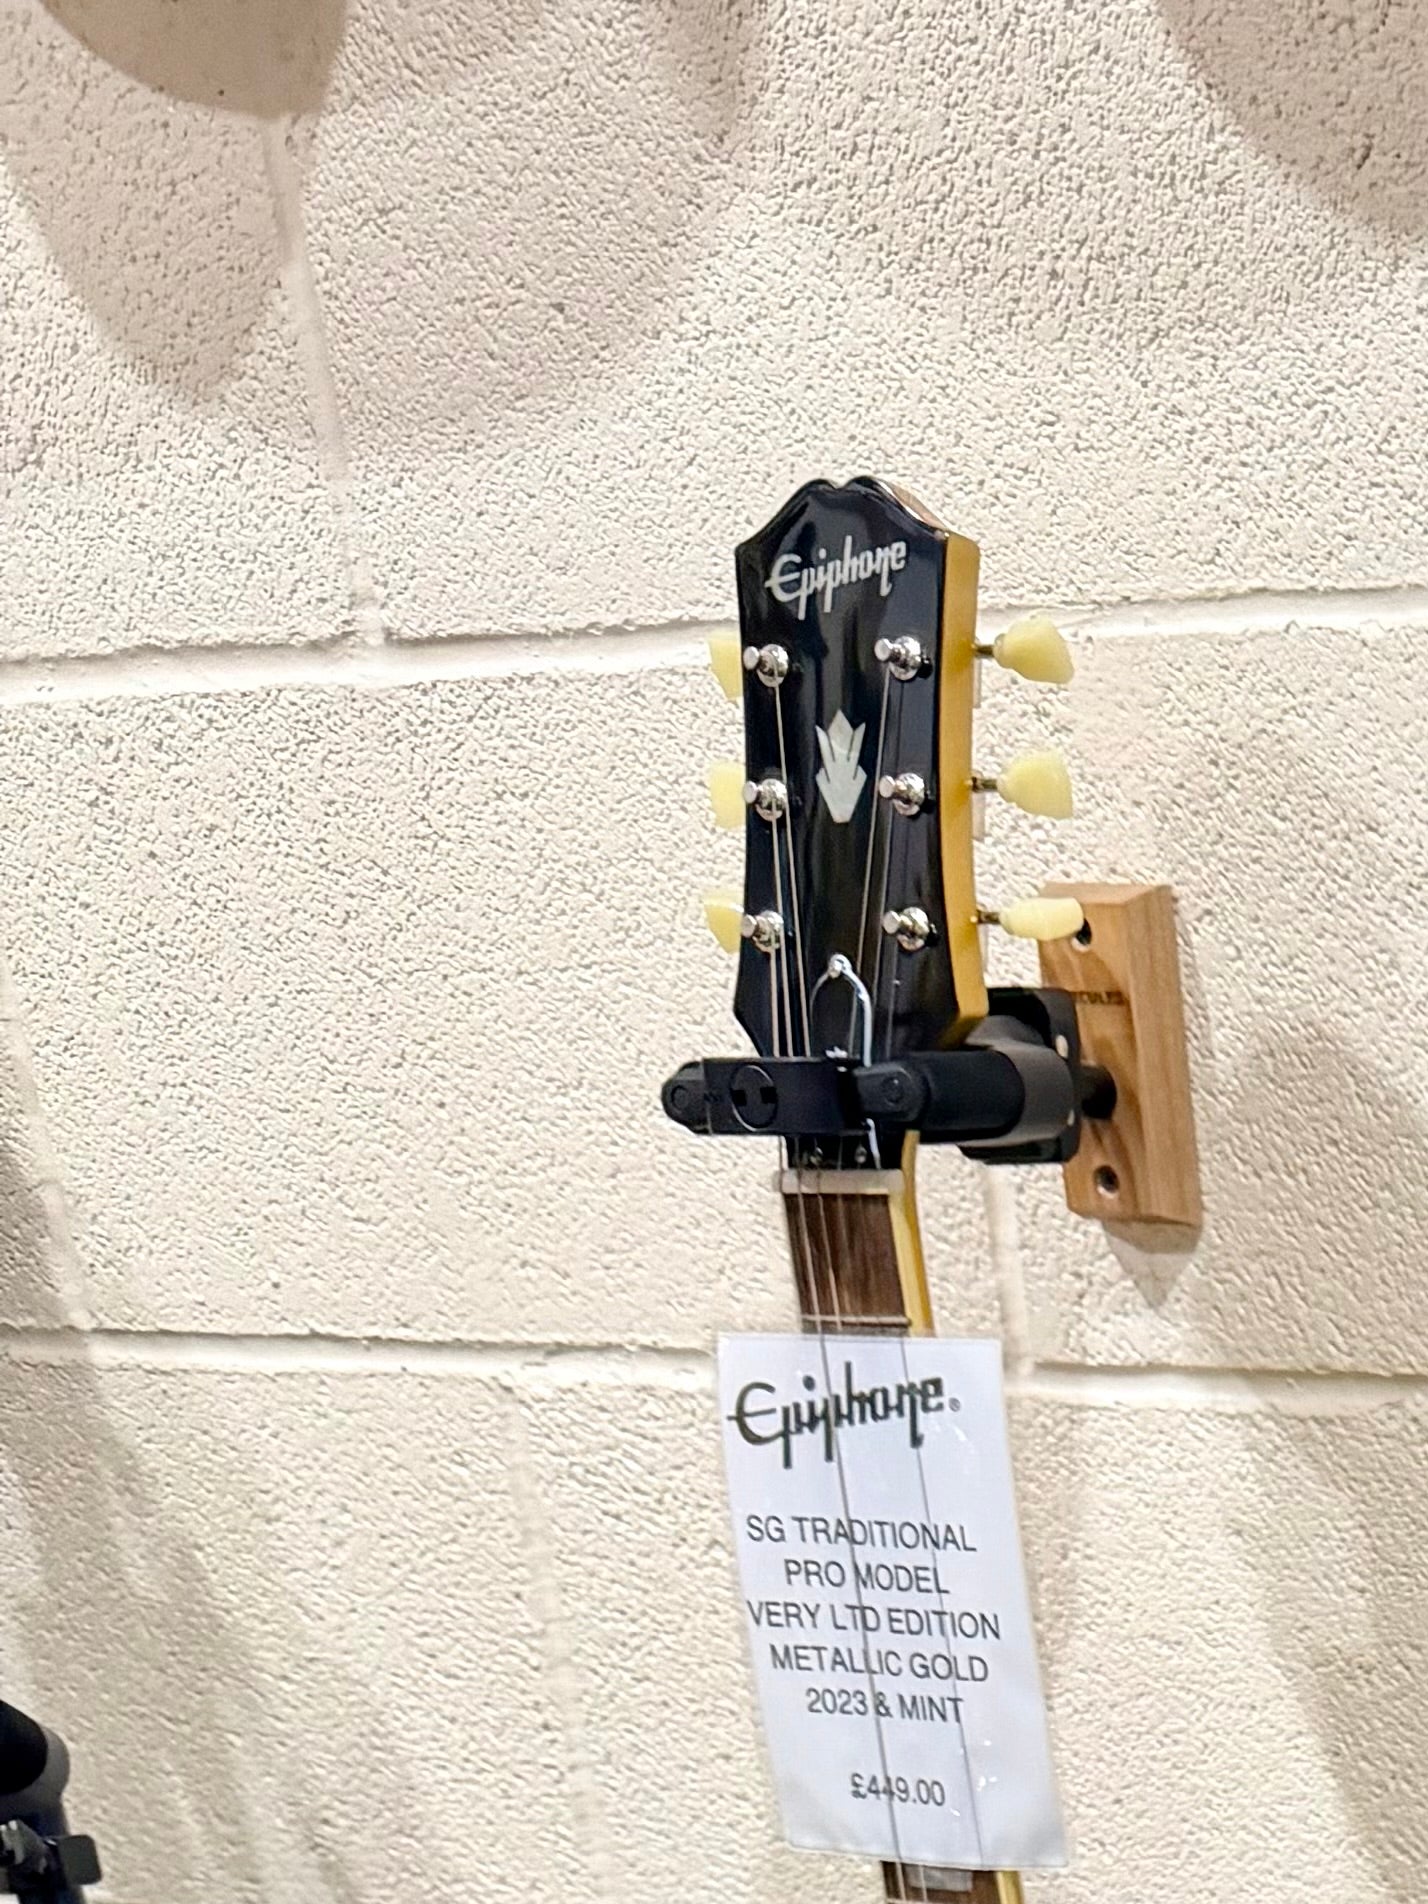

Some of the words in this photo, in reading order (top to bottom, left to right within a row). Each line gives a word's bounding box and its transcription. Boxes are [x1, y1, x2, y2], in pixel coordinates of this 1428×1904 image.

[765, 535, 908, 620] Epiphone
[727, 1361, 945, 1469] Epiphone
[746, 1515, 787, 1545] SG
[792, 1517, 977, 1553] TRADITIONAL
[785, 1558, 846, 1588] PRO
[855, 1564, 950, 1596] MODEL
[746, 1601, 820, 1630] VERY
[830, 1604, 881, 1634] LTD
[888, 1609, 1000, 1640] EDITION
[770, 1645, 902, 1677] METALLIC
[909, 1653, 988, 1682] GOLD
[806, 1688, 868, 1716] 2023
[875, 1692, 892, 1717] &
[898, 1695, 963, 1724] MINT
[851, 1773, 946, 1806] £449.00
